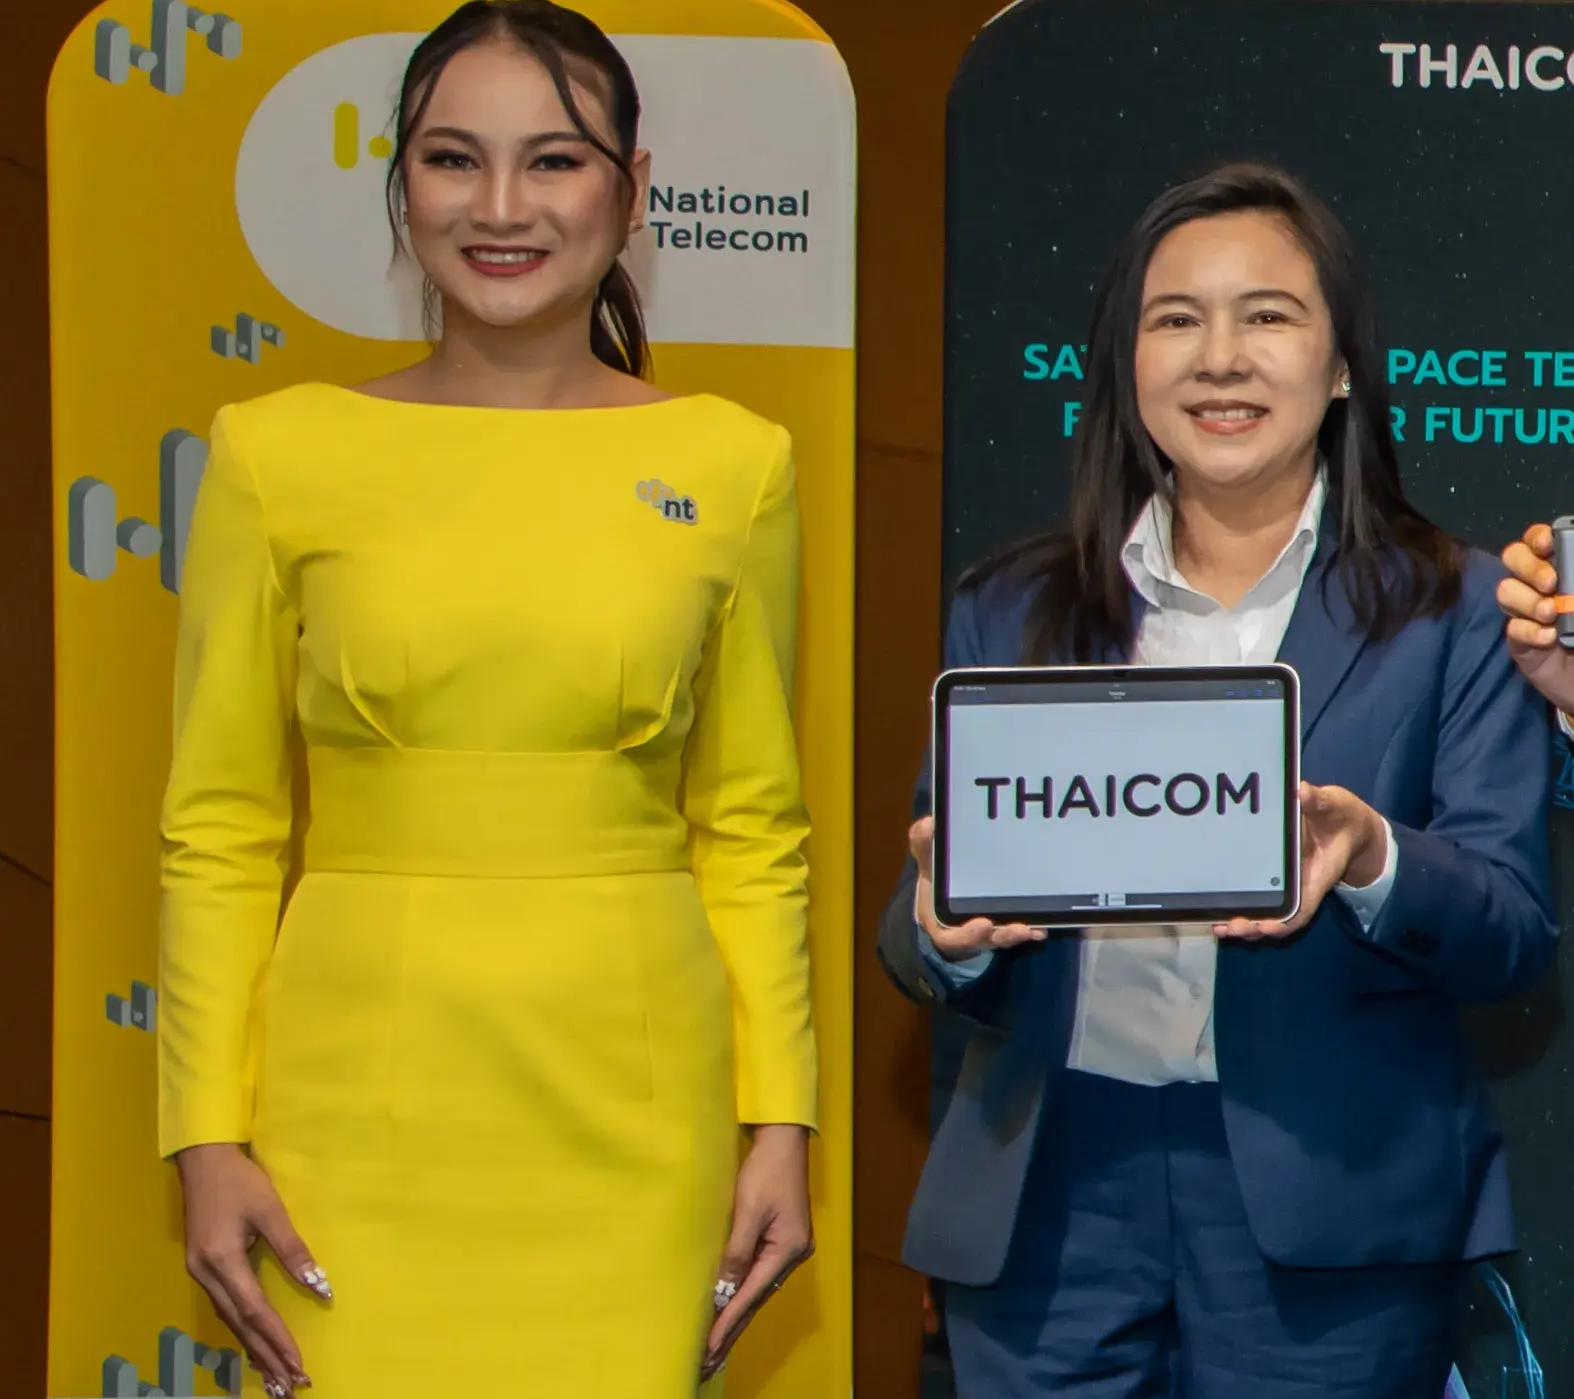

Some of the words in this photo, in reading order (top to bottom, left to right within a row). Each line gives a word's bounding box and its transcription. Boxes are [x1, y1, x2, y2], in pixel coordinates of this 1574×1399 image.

[649, 185, 809, 218] National
[649, 221, 808, 252] Telecom
[1388, 349, 1506, 387] PACE
[974, 771, 1261, 820] THAICOM
